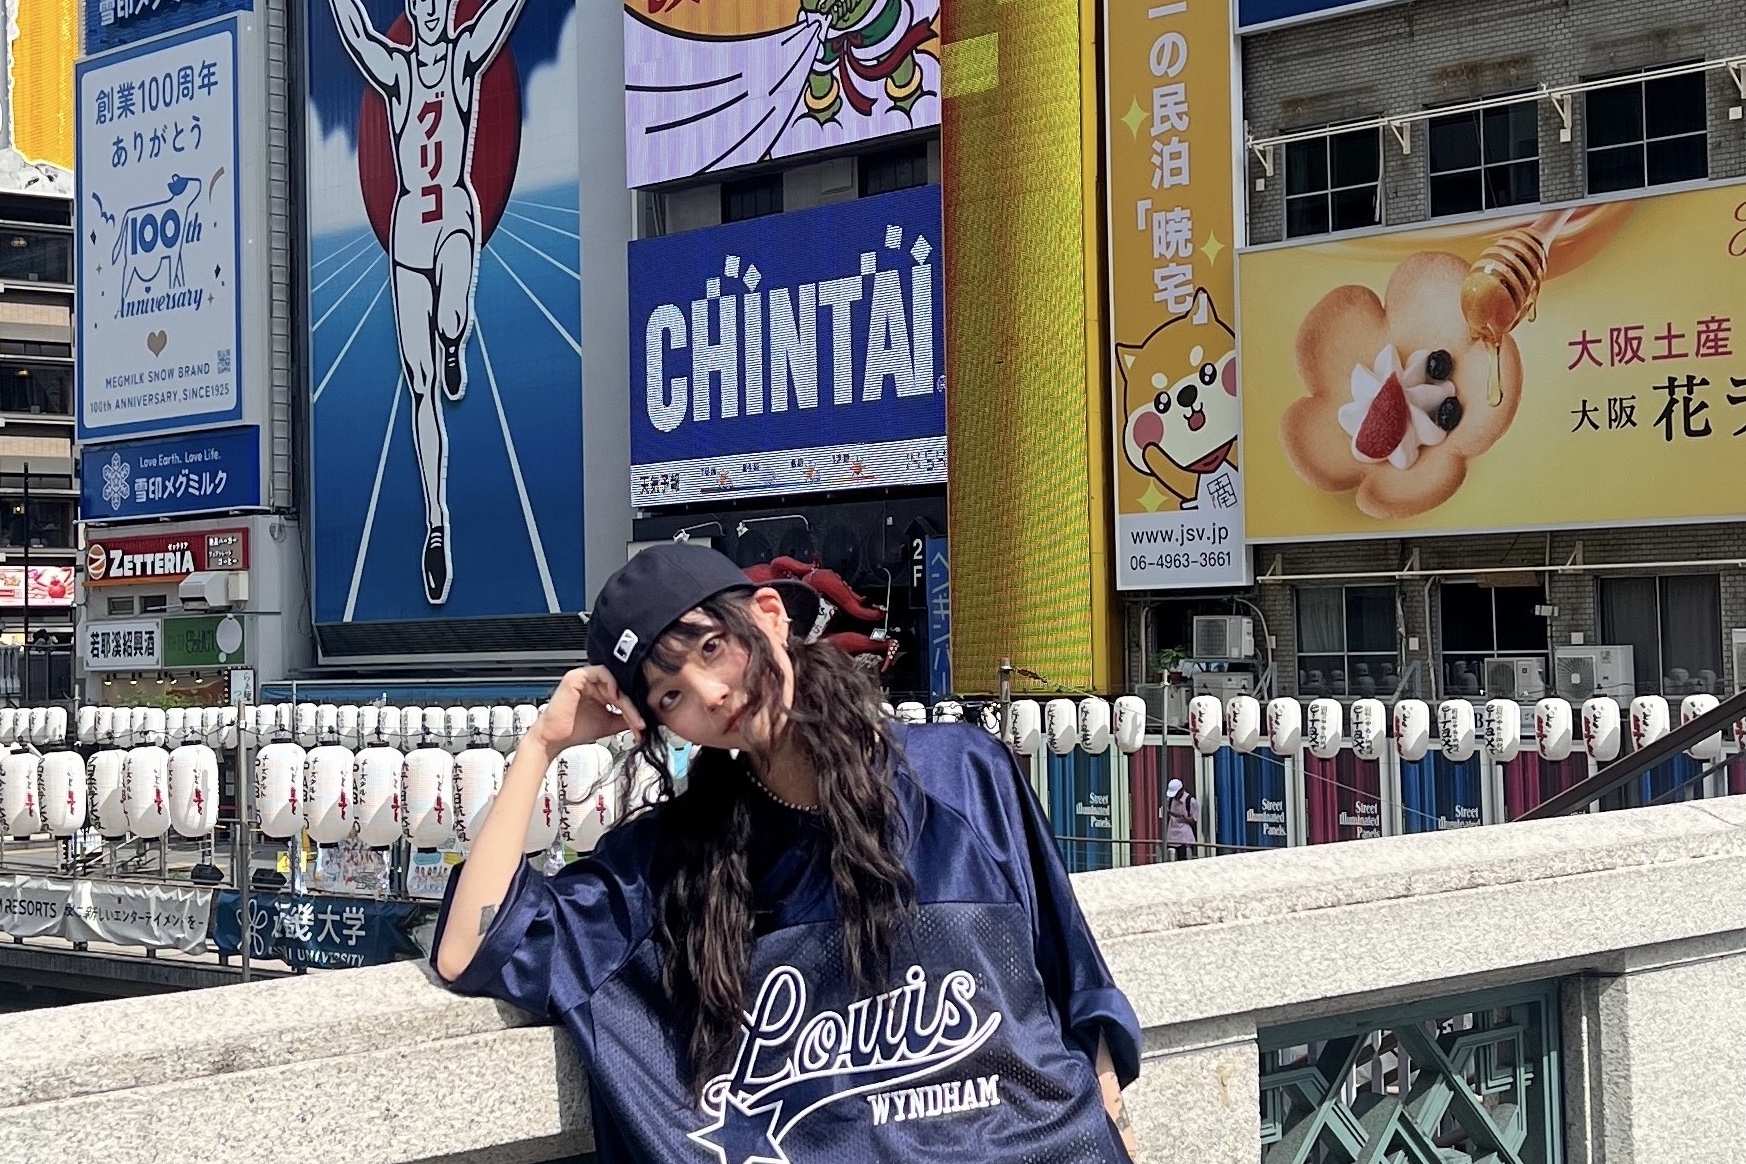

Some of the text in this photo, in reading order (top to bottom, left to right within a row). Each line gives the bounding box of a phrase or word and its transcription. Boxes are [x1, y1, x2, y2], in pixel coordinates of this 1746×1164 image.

[95, 60, 219, 126] 創業100周年
[112, 115, 202, 168] ありがとう
[416, 91, 444, 224] グリコ
[130, 208, 203, 256] 100th
[114, 288, 203, 319] Anniversary
[645, 224, 935, 432] CHINTAI
[1567, 315, 1733, 371] 大阪土産
[105, 362, 210, 390] MEGMILK SNOW BRAND
[90, 400, 112, 414] 100th
[1570, 394, 1638, 433] 大阪
[139, 447, 222, 468] Love Earth. Love Life.
[134, 469, 227, 503] 雪印メグミルク
[1130, 522, 1229, 547] www.jsv.jp
[109, 549, 195, 578] ZETTERIA
[1130, 551, 1231, 571] 06-4963-3661
[1090, 791, 1109, 804] Street
[1261, 798, 1283, 811] Street
[1355, 800, 1378, 814] Street
[1455, 804, 1479, 819] Street
[4, 898, 57, 918] RESORTS
[298, 948, 365, 967] UNIVERSITY
[701, 965, 980, 1117] Louis
[867, 1074, 1001, 1126] WYNDHAM
